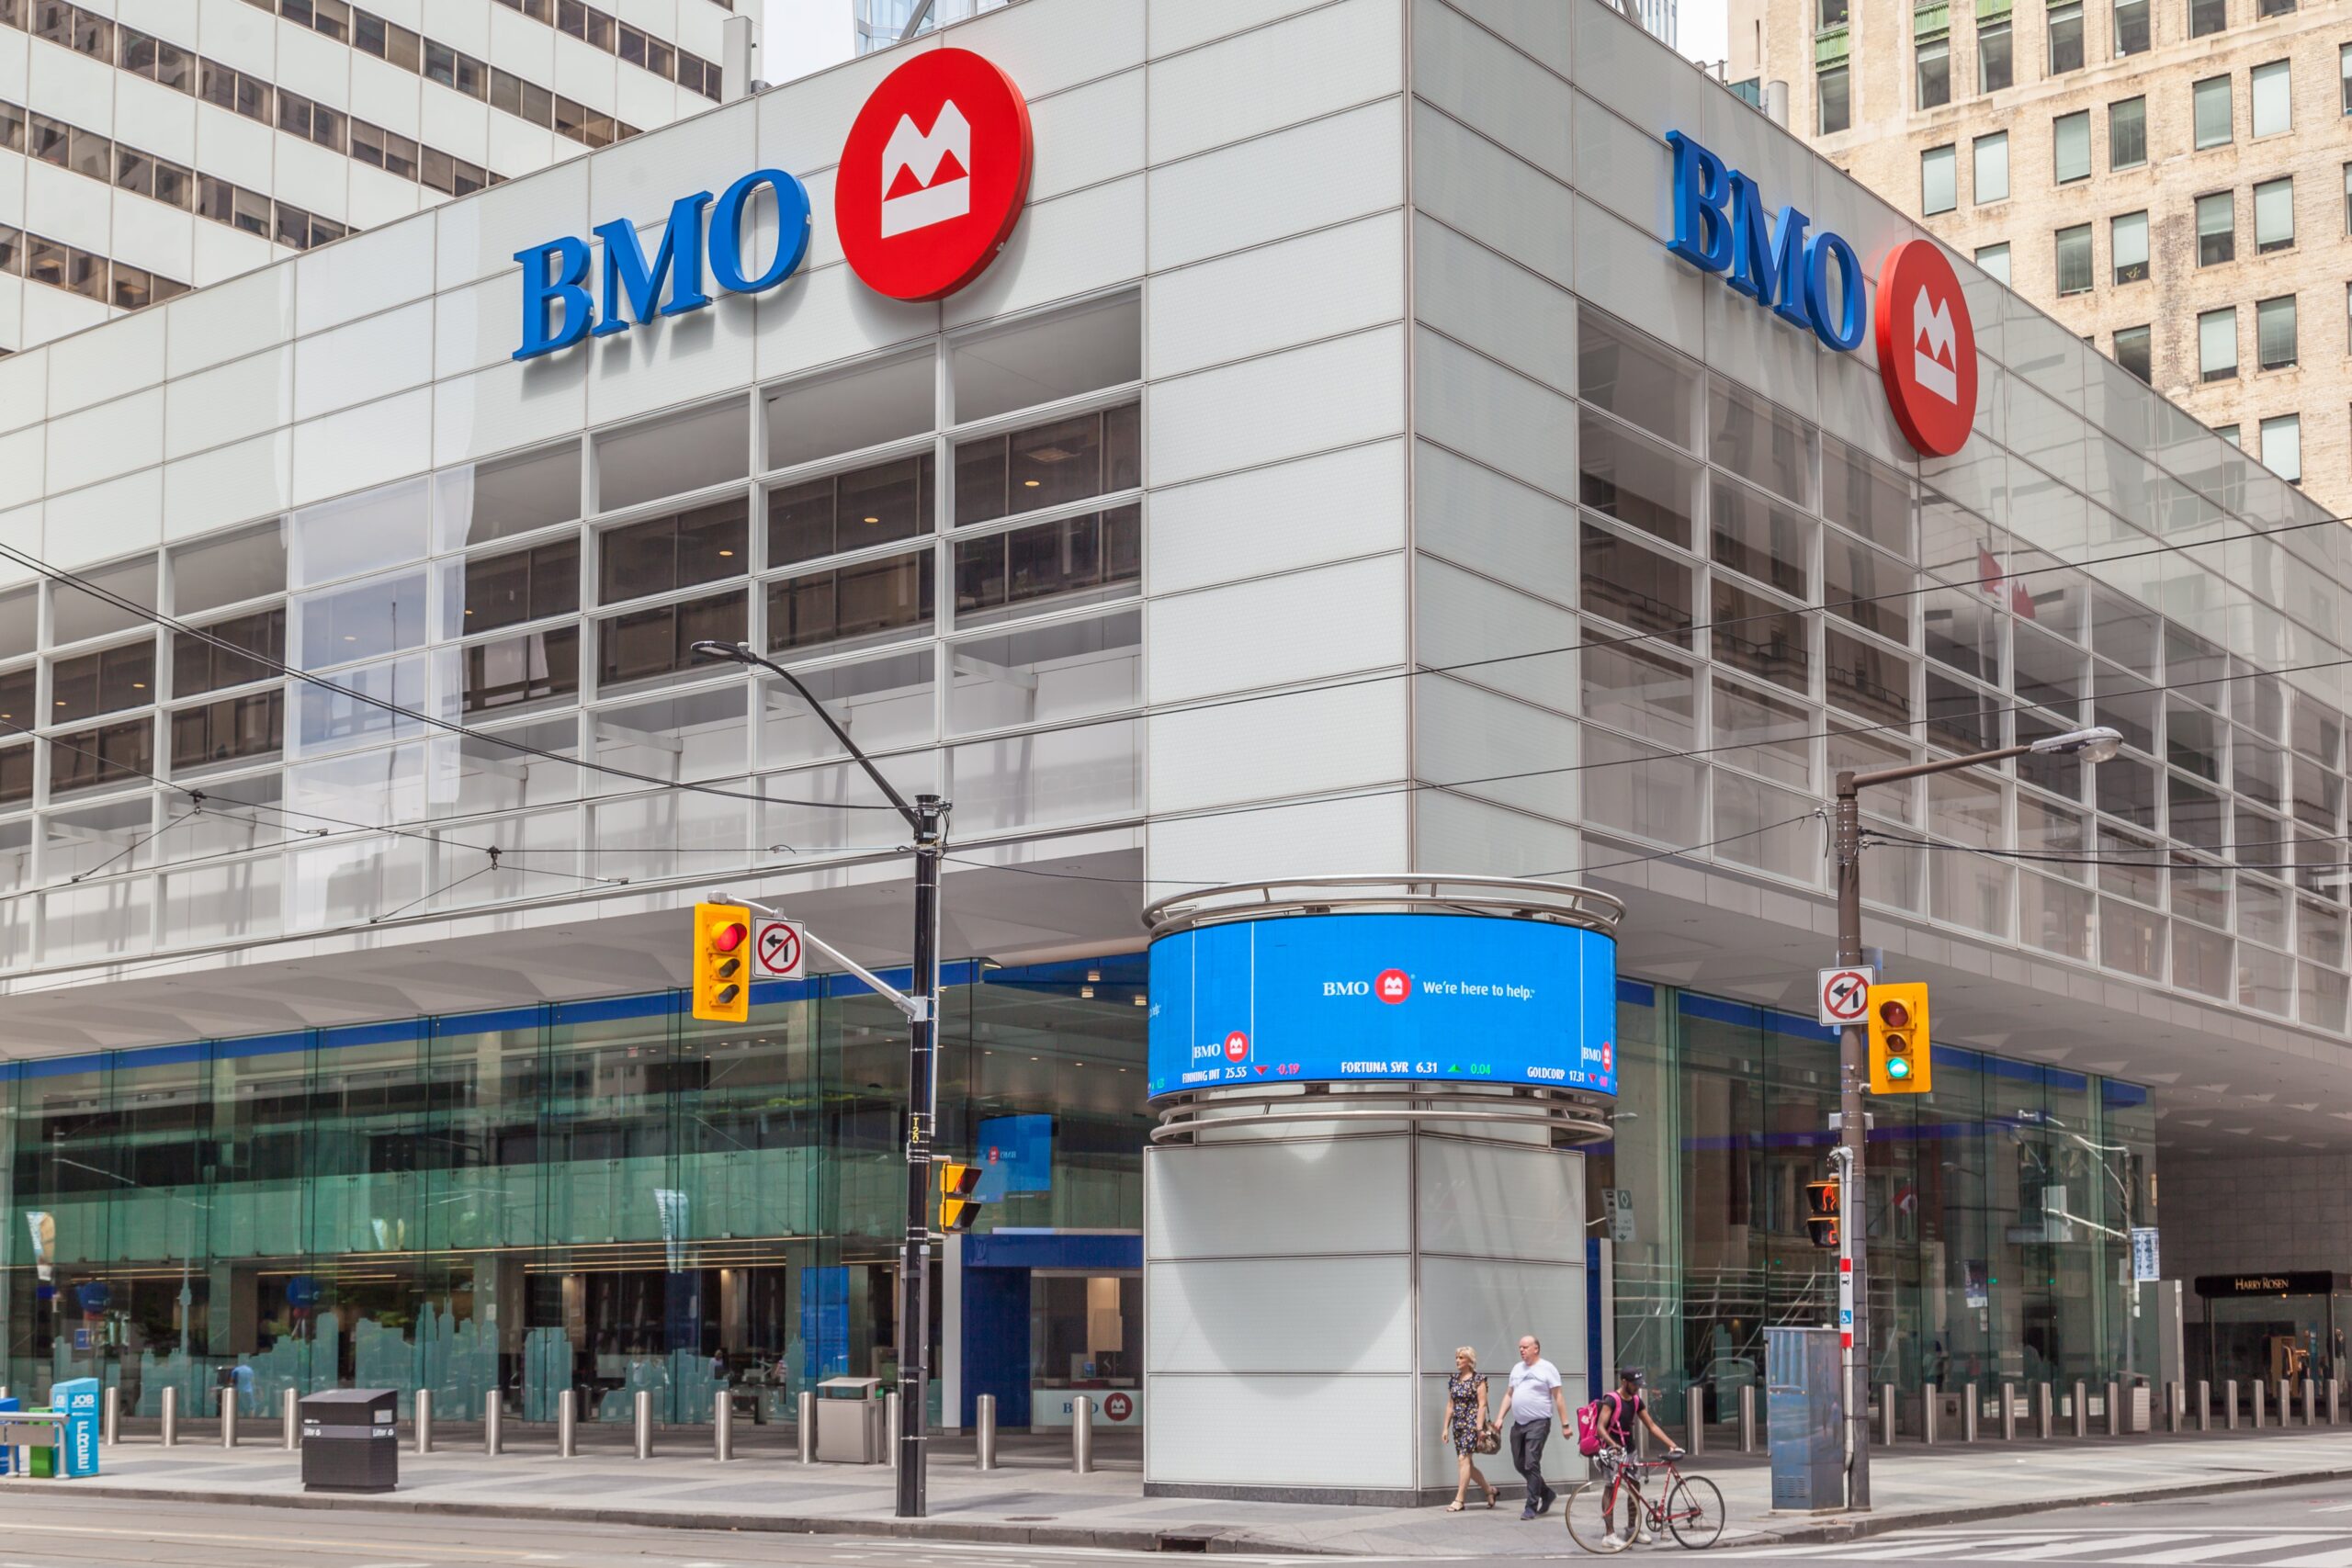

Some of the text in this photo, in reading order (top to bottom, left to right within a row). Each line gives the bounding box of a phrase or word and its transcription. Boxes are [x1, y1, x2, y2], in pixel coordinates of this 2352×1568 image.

[1665, 130, 1867, 352] BMO
[513, 168, 810, 361] BMO
[1323, 981, 1370, 996] BMO
[1423, 980, 1533, 1001] We're here to help.
[1193, 1043, 1221, 1058] BMO
[1582, 1047, 1601, 1063] BMO
[1225, 1066, 1248, 1079] 25.55
[1340, 1061, 1491, 1075] FORTUNA SVR 6.31 0.04
[1527, 1066, 1566, 1080] GOLDCORP
[1569, 1069, 1585, 1083] 17.31
[72, 1393, 95, 1406] JOB
[1063, 1402, 1099, 1414] BO
[77, 1420, 90, 1470] FREE
